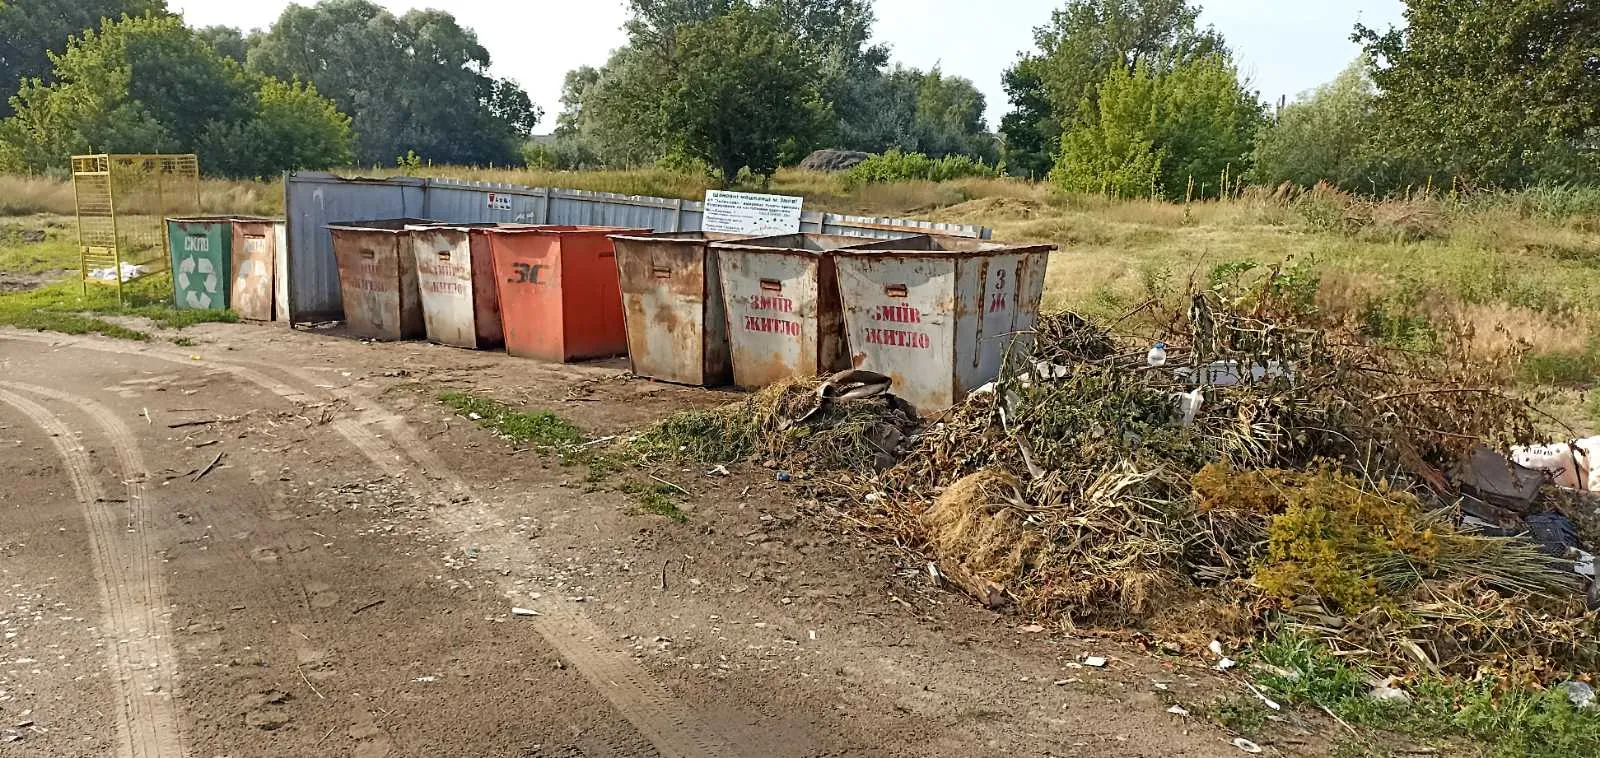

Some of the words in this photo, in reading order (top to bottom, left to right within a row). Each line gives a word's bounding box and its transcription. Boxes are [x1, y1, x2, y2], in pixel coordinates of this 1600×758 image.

[184, 236, 209, 252] СКЛО
[751, 294, 792, 312] ЗМІЇВ
[872, 302, 921, 324] ЗМІЇВ
[744, 315, 801, 337] ЖИТЛО
[864, 327, 930, 349] ЖИТЛО
